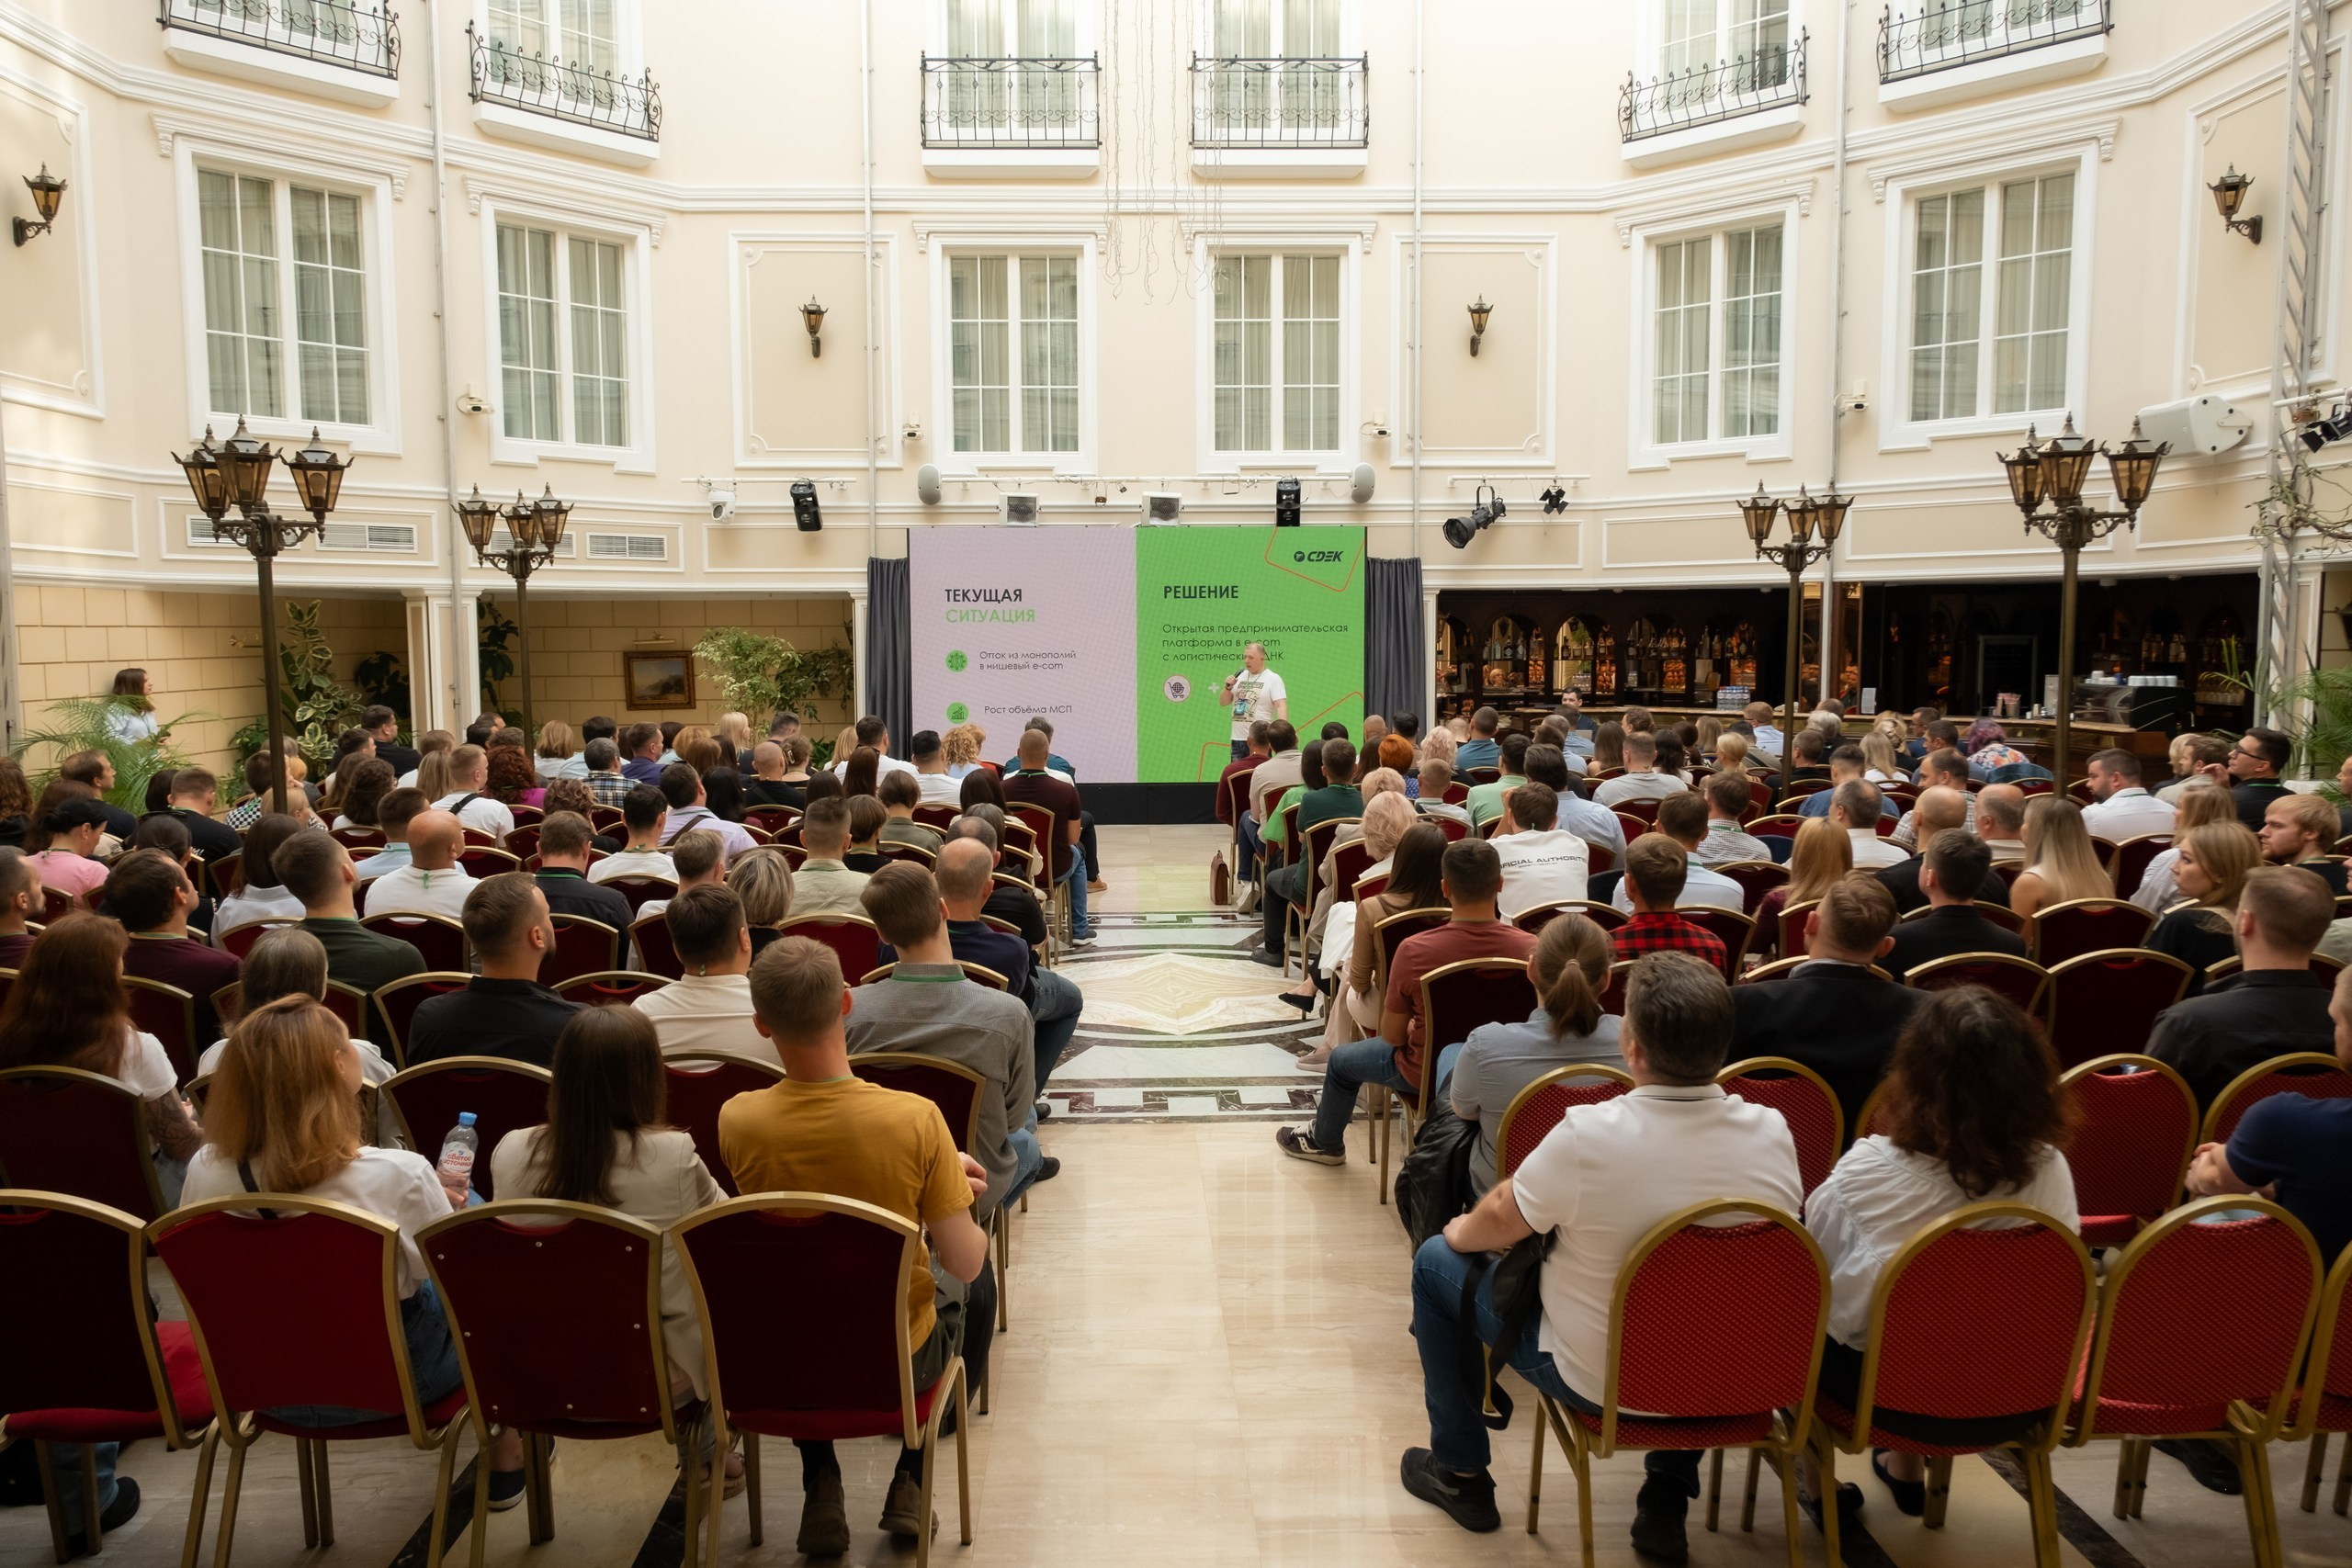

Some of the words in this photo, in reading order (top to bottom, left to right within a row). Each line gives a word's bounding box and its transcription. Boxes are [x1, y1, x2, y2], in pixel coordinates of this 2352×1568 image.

[1306, 551, 1344, 562] CDEK
[944, 589, 1023, 604] ТЕКУЩАЯ
[1163, 585, 1238, 599] РЕШЕНИЕ
[945, 609, 1035, 625] СИТУАЦИЯ
[1162, 624, 1215, 635] Открытая
[1217, 624, 1349, 635] предпринимательская
[1162, 637, 1233, 649] платформа
[979, 651, 1007, 660] Отток
[1021, 650, 1077, 660] монополий
[987, 661, 1030, 670] нишевый
[984, 705, 1006, 714] Рост
[1008, 705, 1047, 714] объёма
[1049, 705, 1073, 714] МСП
